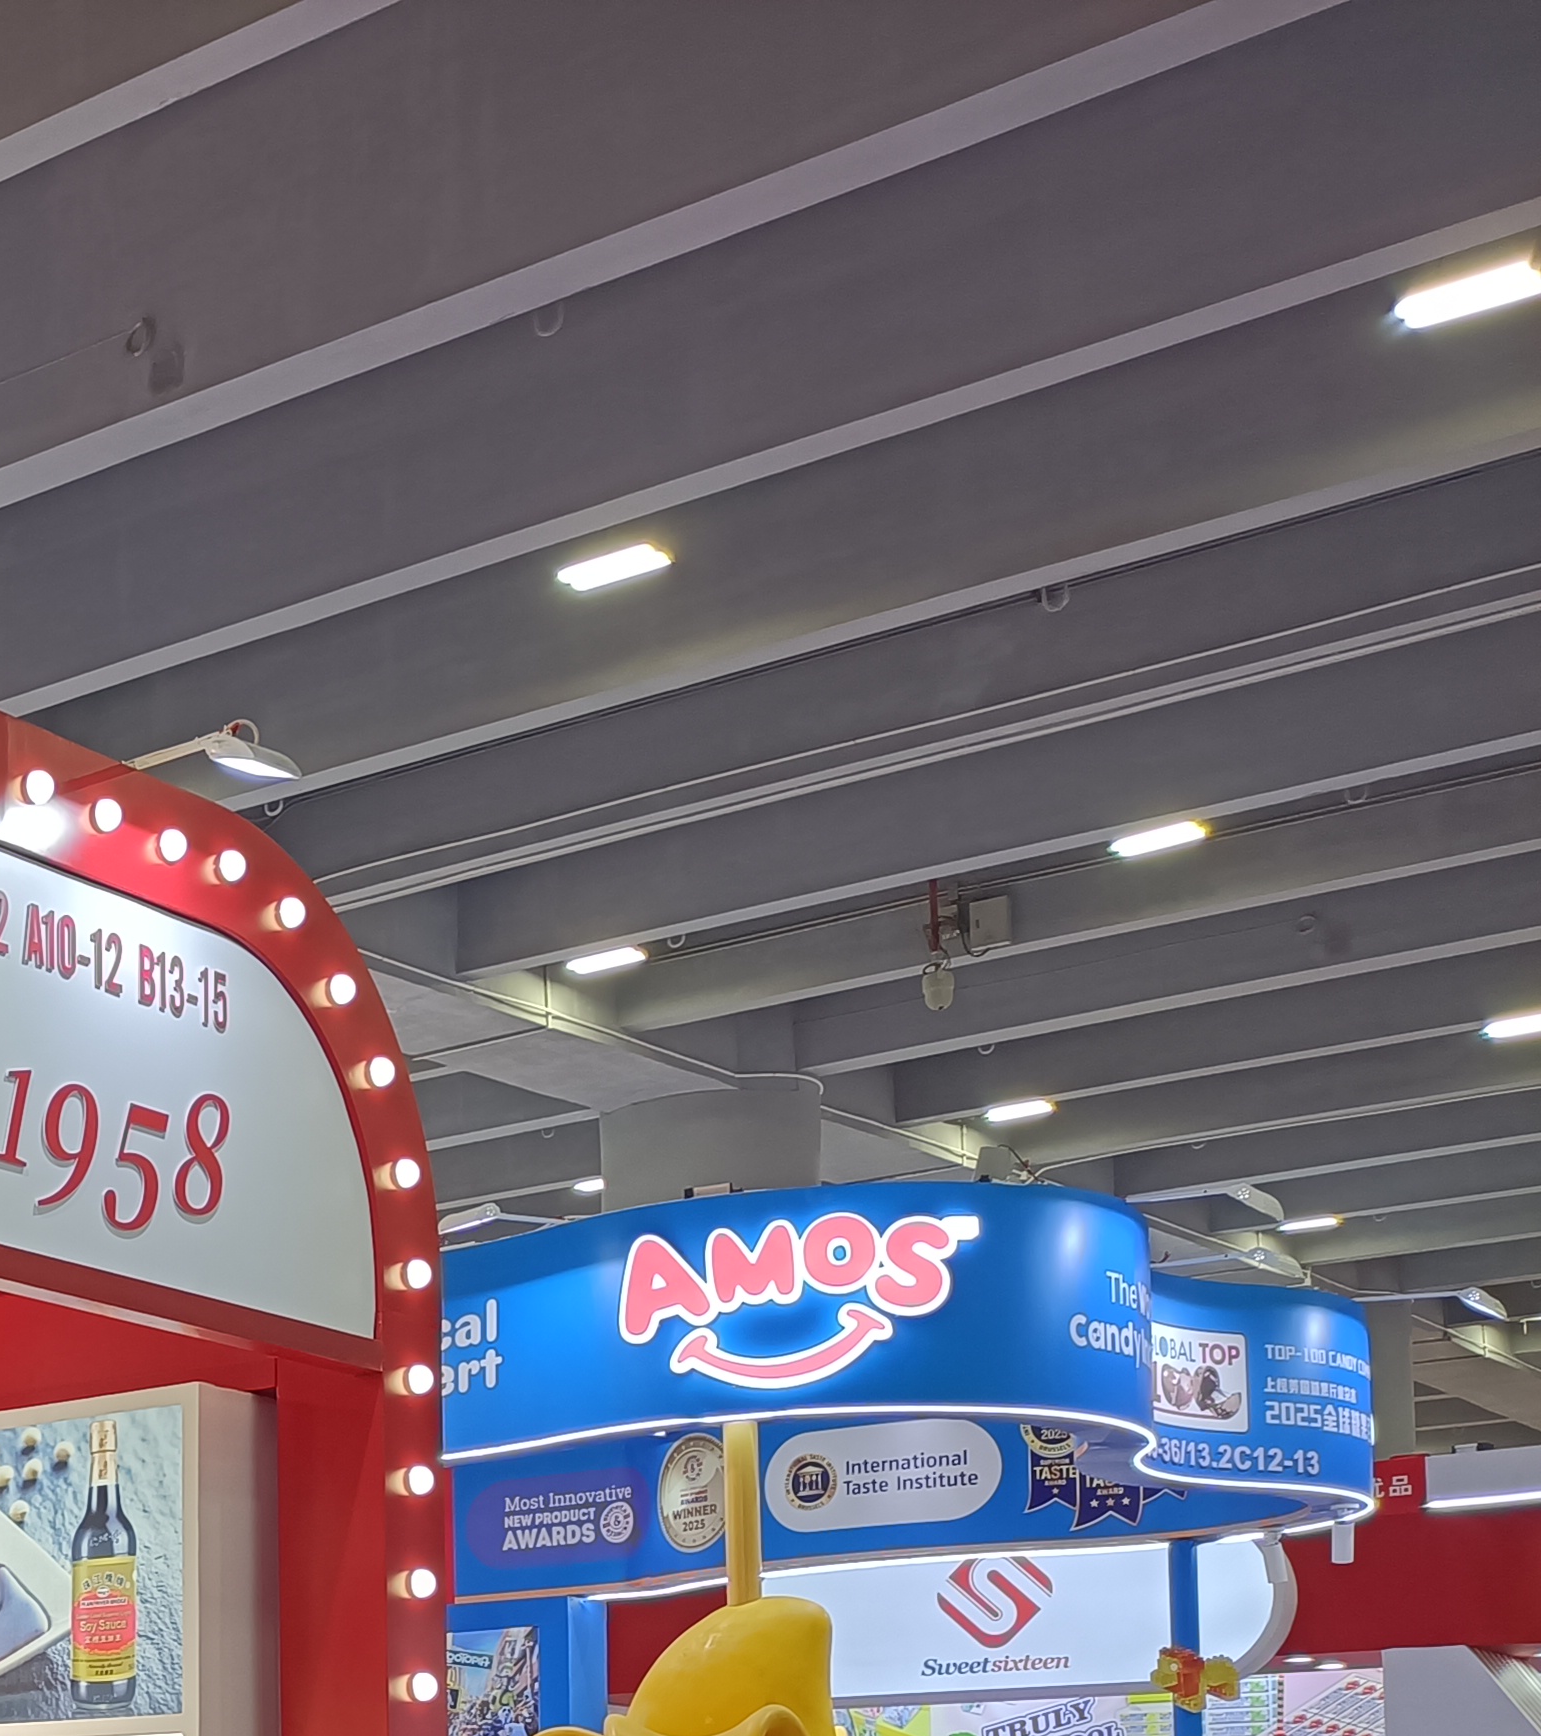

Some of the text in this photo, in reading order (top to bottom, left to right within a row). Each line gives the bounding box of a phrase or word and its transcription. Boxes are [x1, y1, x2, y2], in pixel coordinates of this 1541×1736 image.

[21, 903, 124, 997] A10-12
[138, 943, 230, 1033] B13-15
[619, 1211, 953, 1345] AMOS
[1105, 1270, 1138, 1309] The
[1069, 1313, 1141, 1369] Candy
[1152, 1334, 1241, 1366] LOBAL TOP
[1265, 1344, 1327, 1365] TOP-100
[1328, 1351, 1358, 1373] CANDY
[845, 1450, 969, 1475] International
[1033, 1465, 1078, 1480] TASTE
[842, 1472, 979, 1496] Taste Institute
[504, 1485, 633, 1513] Most Innovative
[672, 1504, 718, 1519] WINNER
[503, 1507, 596, 1529] NEW PRODUCT
[682, 1518, 707, 1532] 2025
[502, 1525, 597, 1551] AWARDS
[79, 1618, 128, 1634] Soy Sauce
[921, 1655, 1070, 1677] Sweetsixteen
